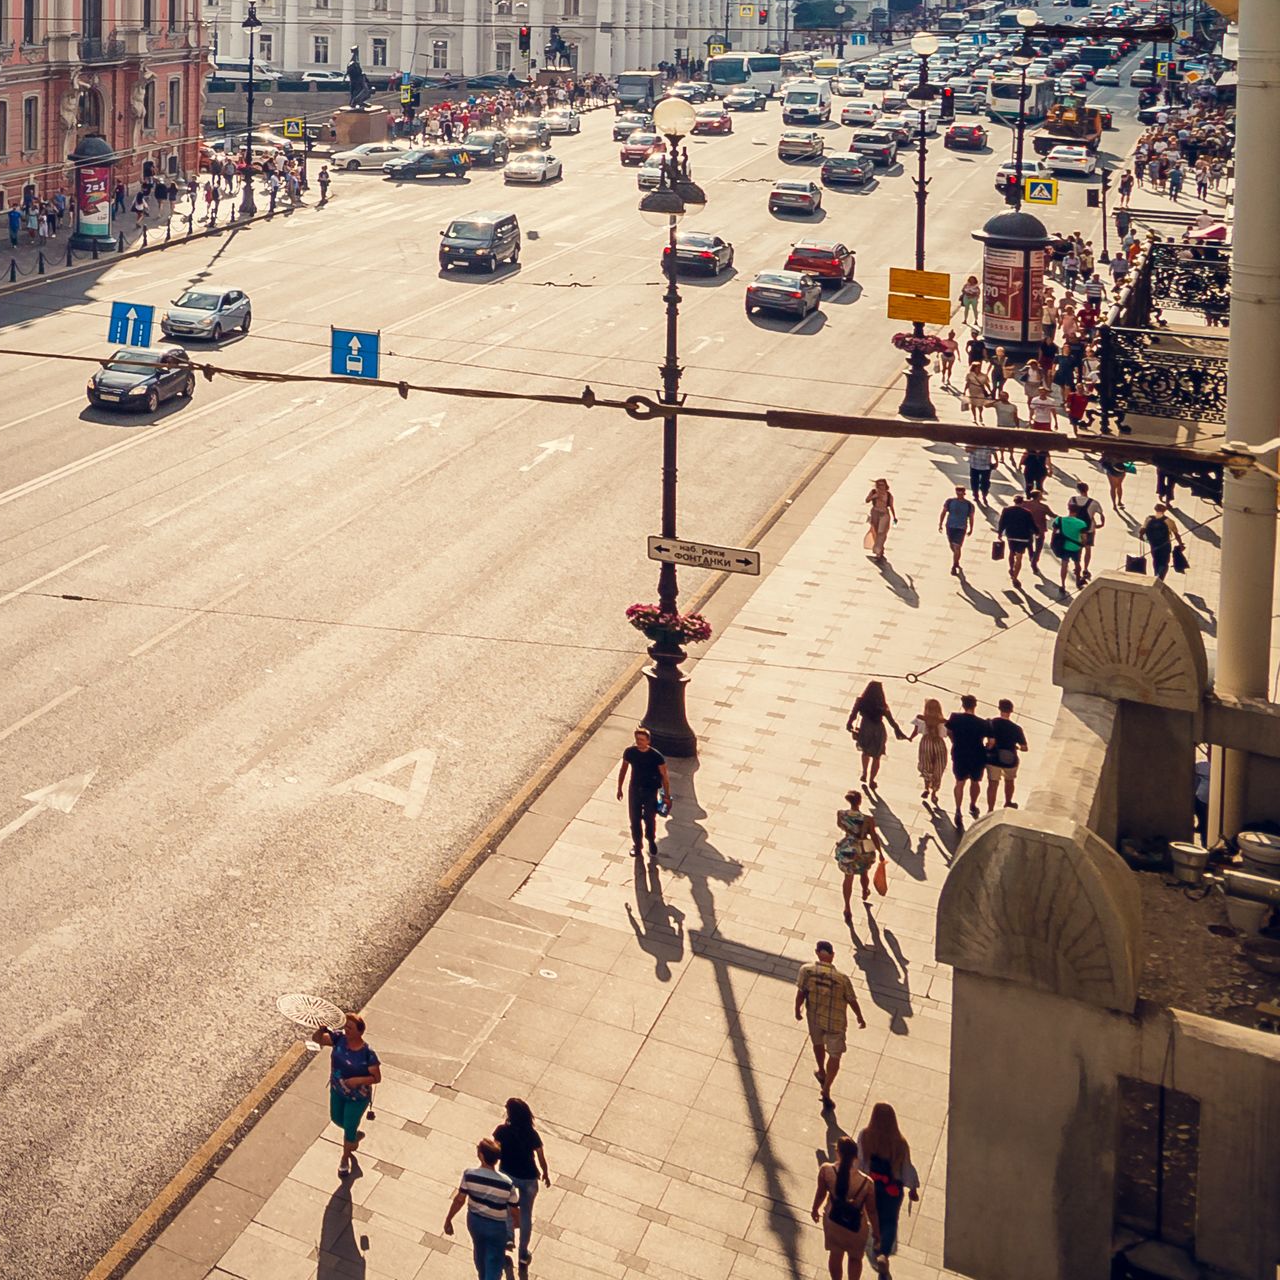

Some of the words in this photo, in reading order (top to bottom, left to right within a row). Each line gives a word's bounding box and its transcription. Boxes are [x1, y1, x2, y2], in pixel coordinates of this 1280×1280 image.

[679, 545, 698, 553] наб.
[701, 548, 725, 557] реки
[674, 552, 731, 567] ФОНТАНКИ
